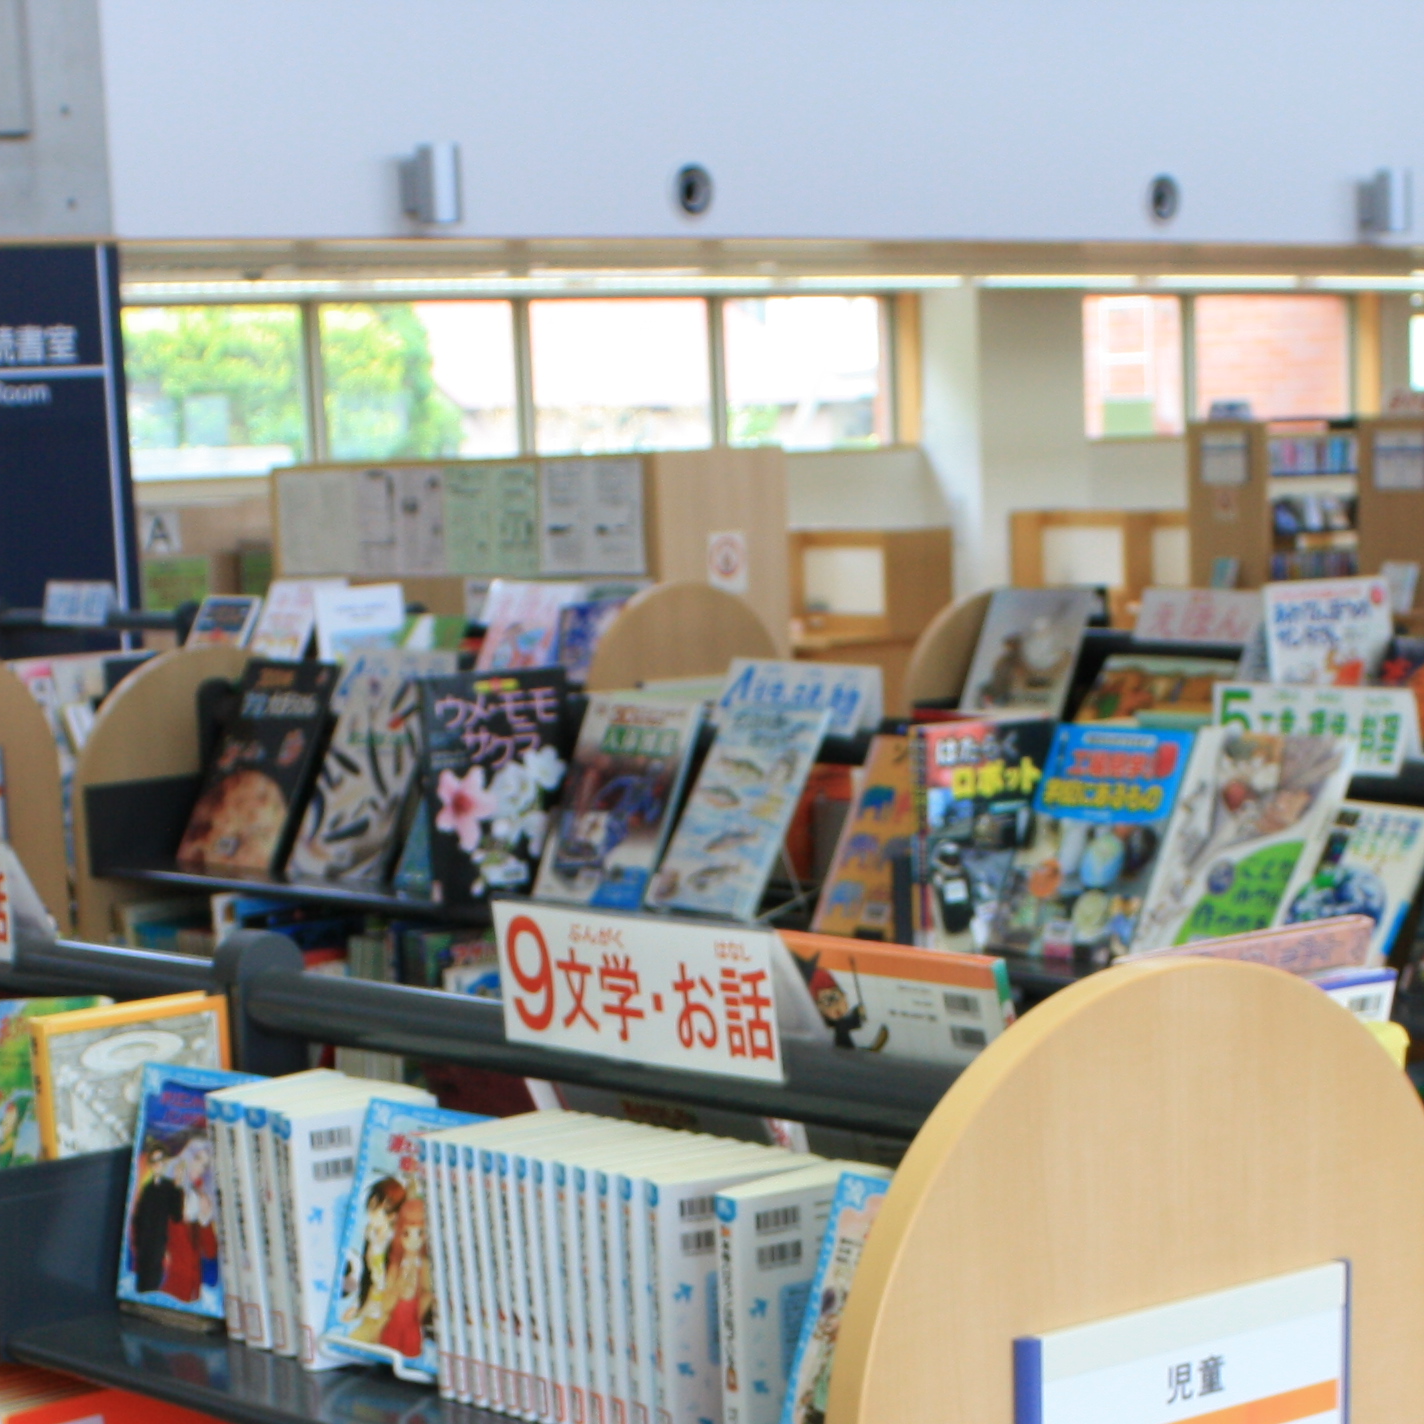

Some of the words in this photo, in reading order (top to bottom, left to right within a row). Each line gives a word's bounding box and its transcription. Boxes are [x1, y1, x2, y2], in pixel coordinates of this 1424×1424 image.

[952, 756, 1042, 800] ロボット
[568, 923, 625, 947] ぶんがく
[507, 915, 775, 1061] 9文学・お話
[1167, 1354, 1225, 1404] 児童
